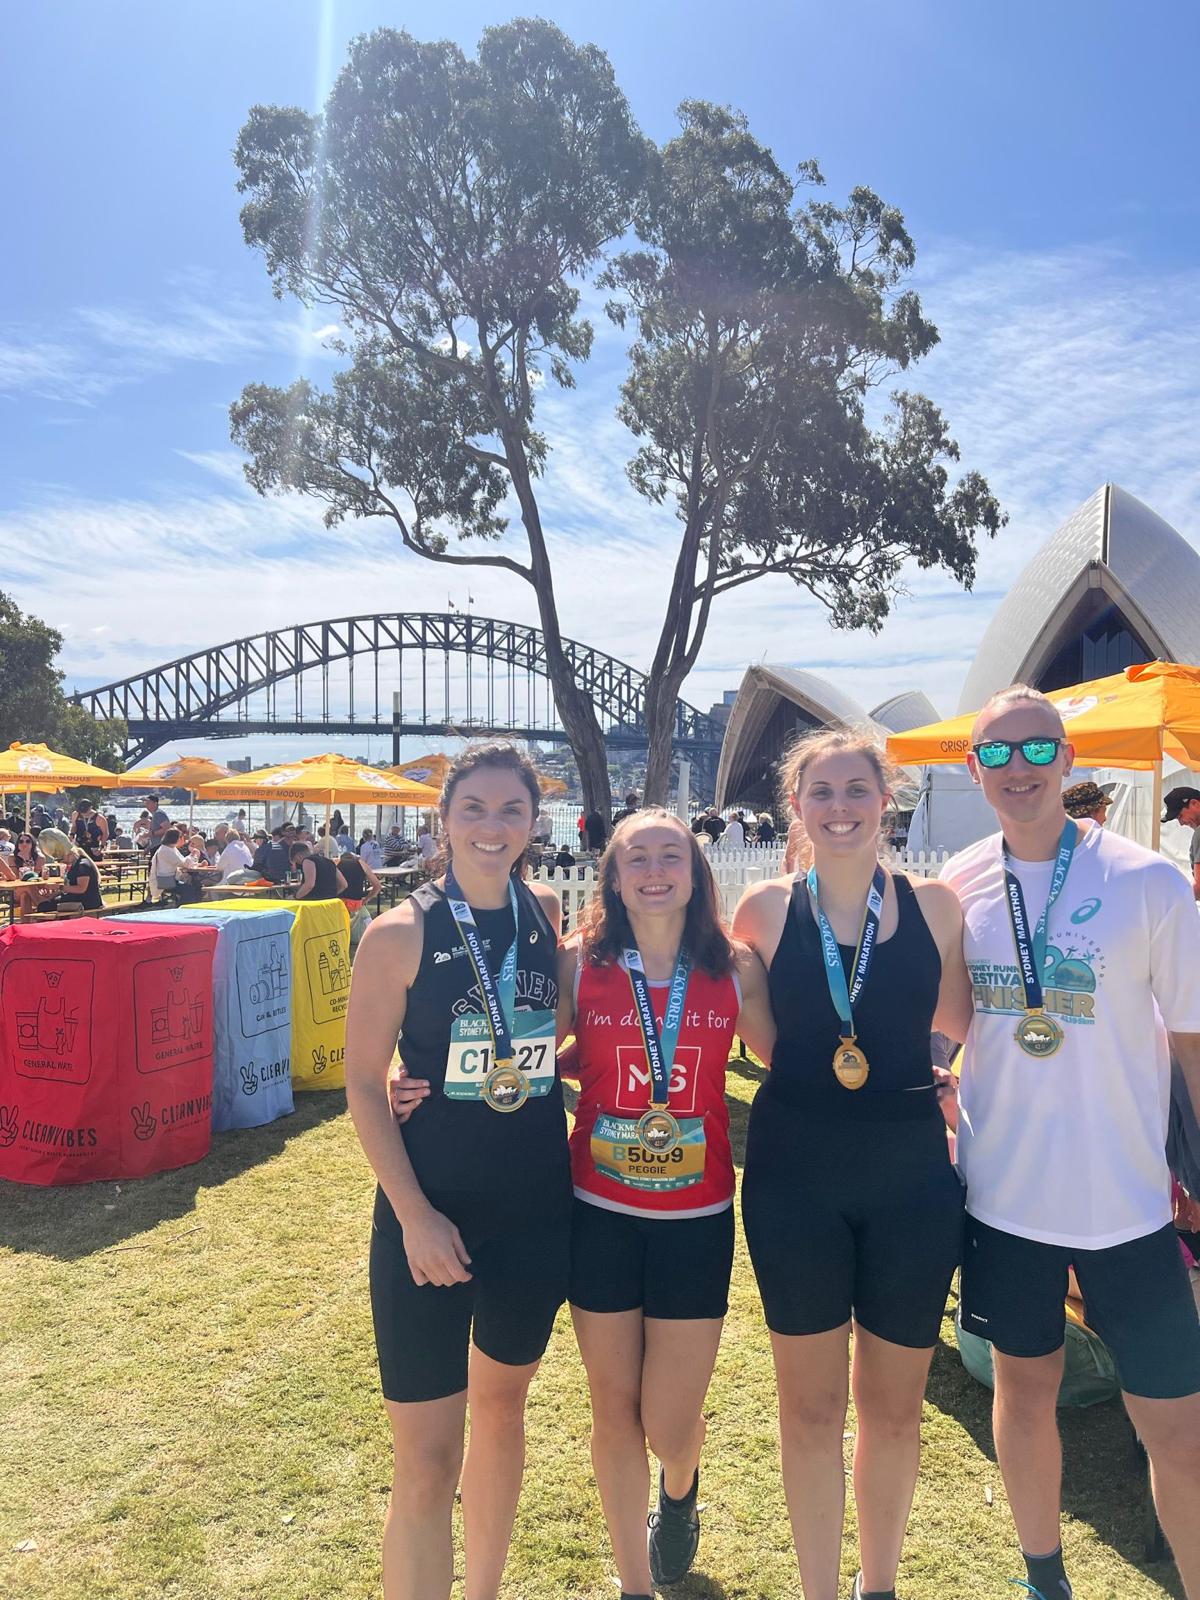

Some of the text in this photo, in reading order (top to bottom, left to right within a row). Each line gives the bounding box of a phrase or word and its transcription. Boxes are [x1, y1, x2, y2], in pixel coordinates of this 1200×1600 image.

[940, 739, 969, 753] CRISP
[276, 790, 305, 799] MODUS
[857, 922, 875, 974] MARATHON
[1009, 883, 1035, 984] SYDNEY MARATHON
[466, 932, 492, 990] MARATHON
[993, 964, 1020, 973] RUNN
[972, 972, 1022, 985] ESTIVA
[486, 993, 504, 1036] SYDNEY
[586, 1010, 612, 1026] I'm
[686, 1010, 701, 1026] it
[708, 1010, 730, 1028] for
[634, 980, 655, 1036] MARATHON
[459, 1044, 548, 1074] C127
[647, 1039, 663, 1081] SYDNEY
[23, 1119, 98, 1148] CLEANVIBES
[600, 1127, 640, 1140] SYDNEY MARA
[628, 1165, 667, 1175] PEGGIE
